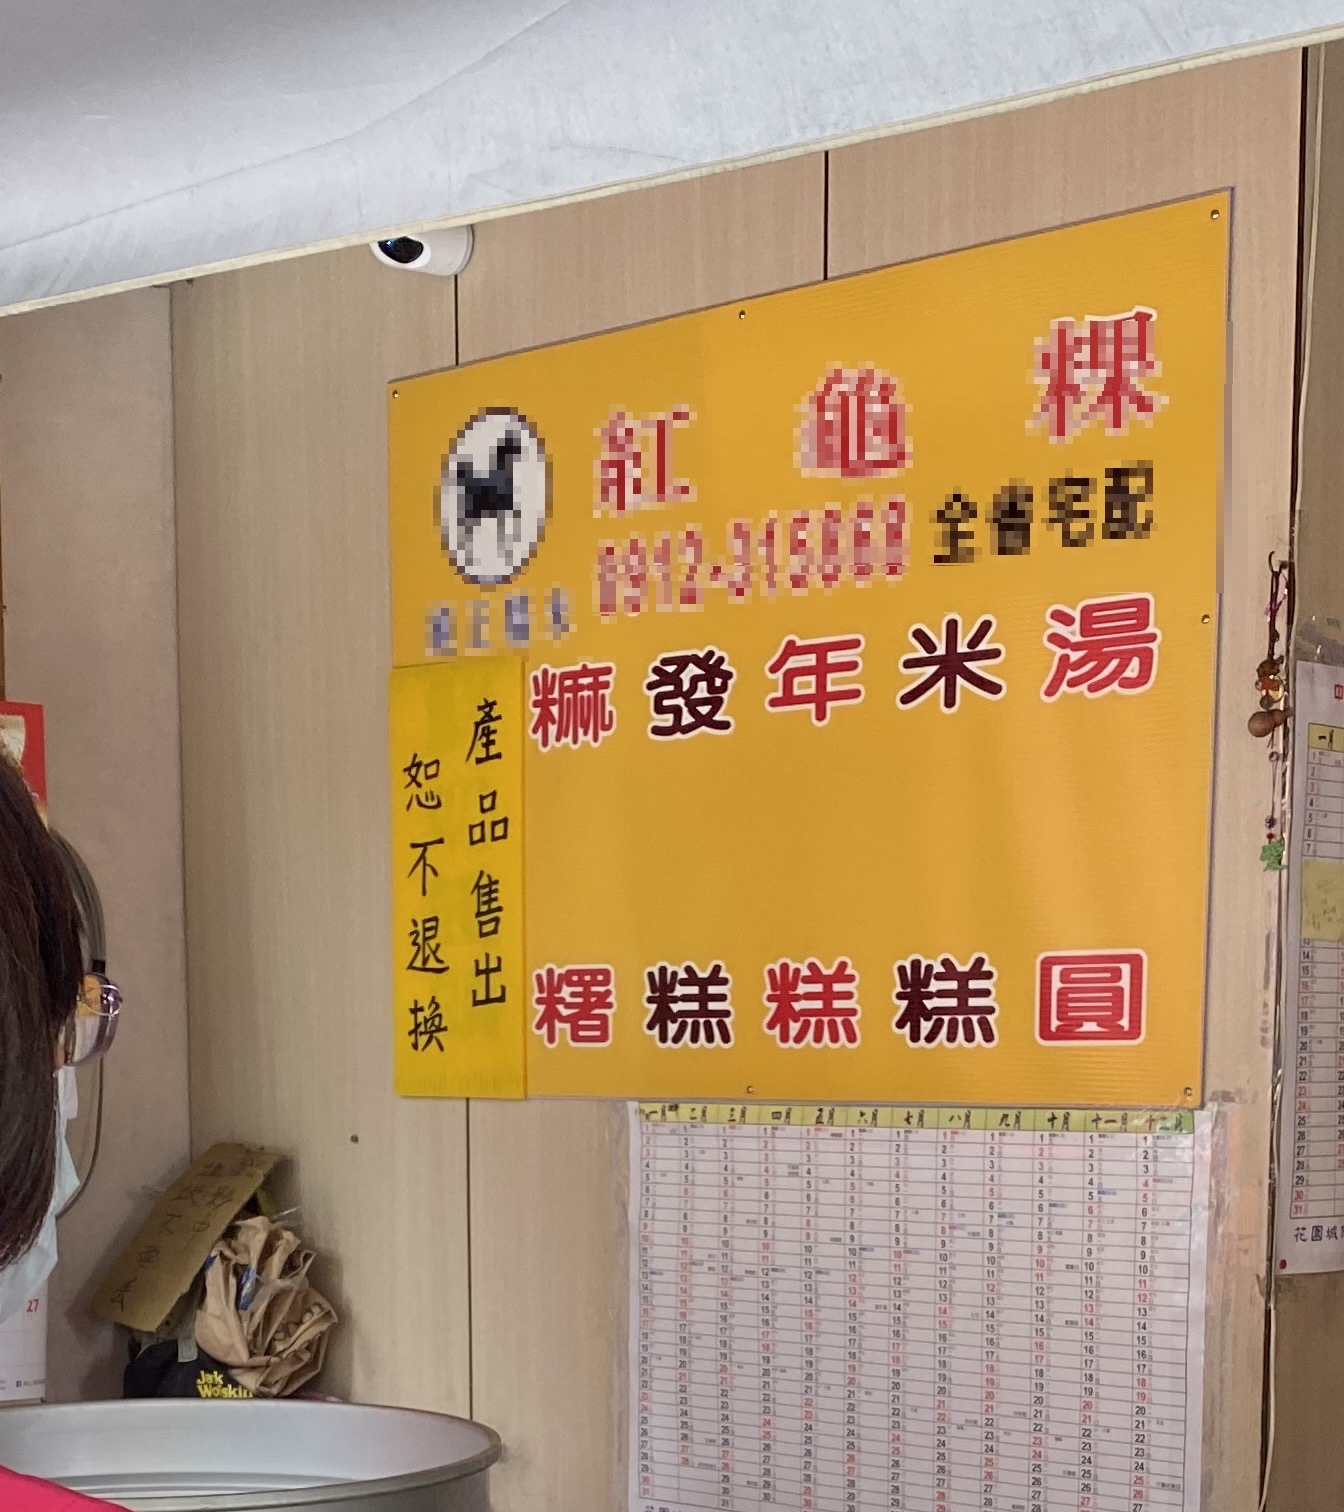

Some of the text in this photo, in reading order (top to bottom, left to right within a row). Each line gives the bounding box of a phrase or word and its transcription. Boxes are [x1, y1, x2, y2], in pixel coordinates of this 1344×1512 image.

[403, 754, 449, 1053] 恕不退換
[465, 699, 509, 1007] 產品售出
[25, 1298, 40, 1313] 27
